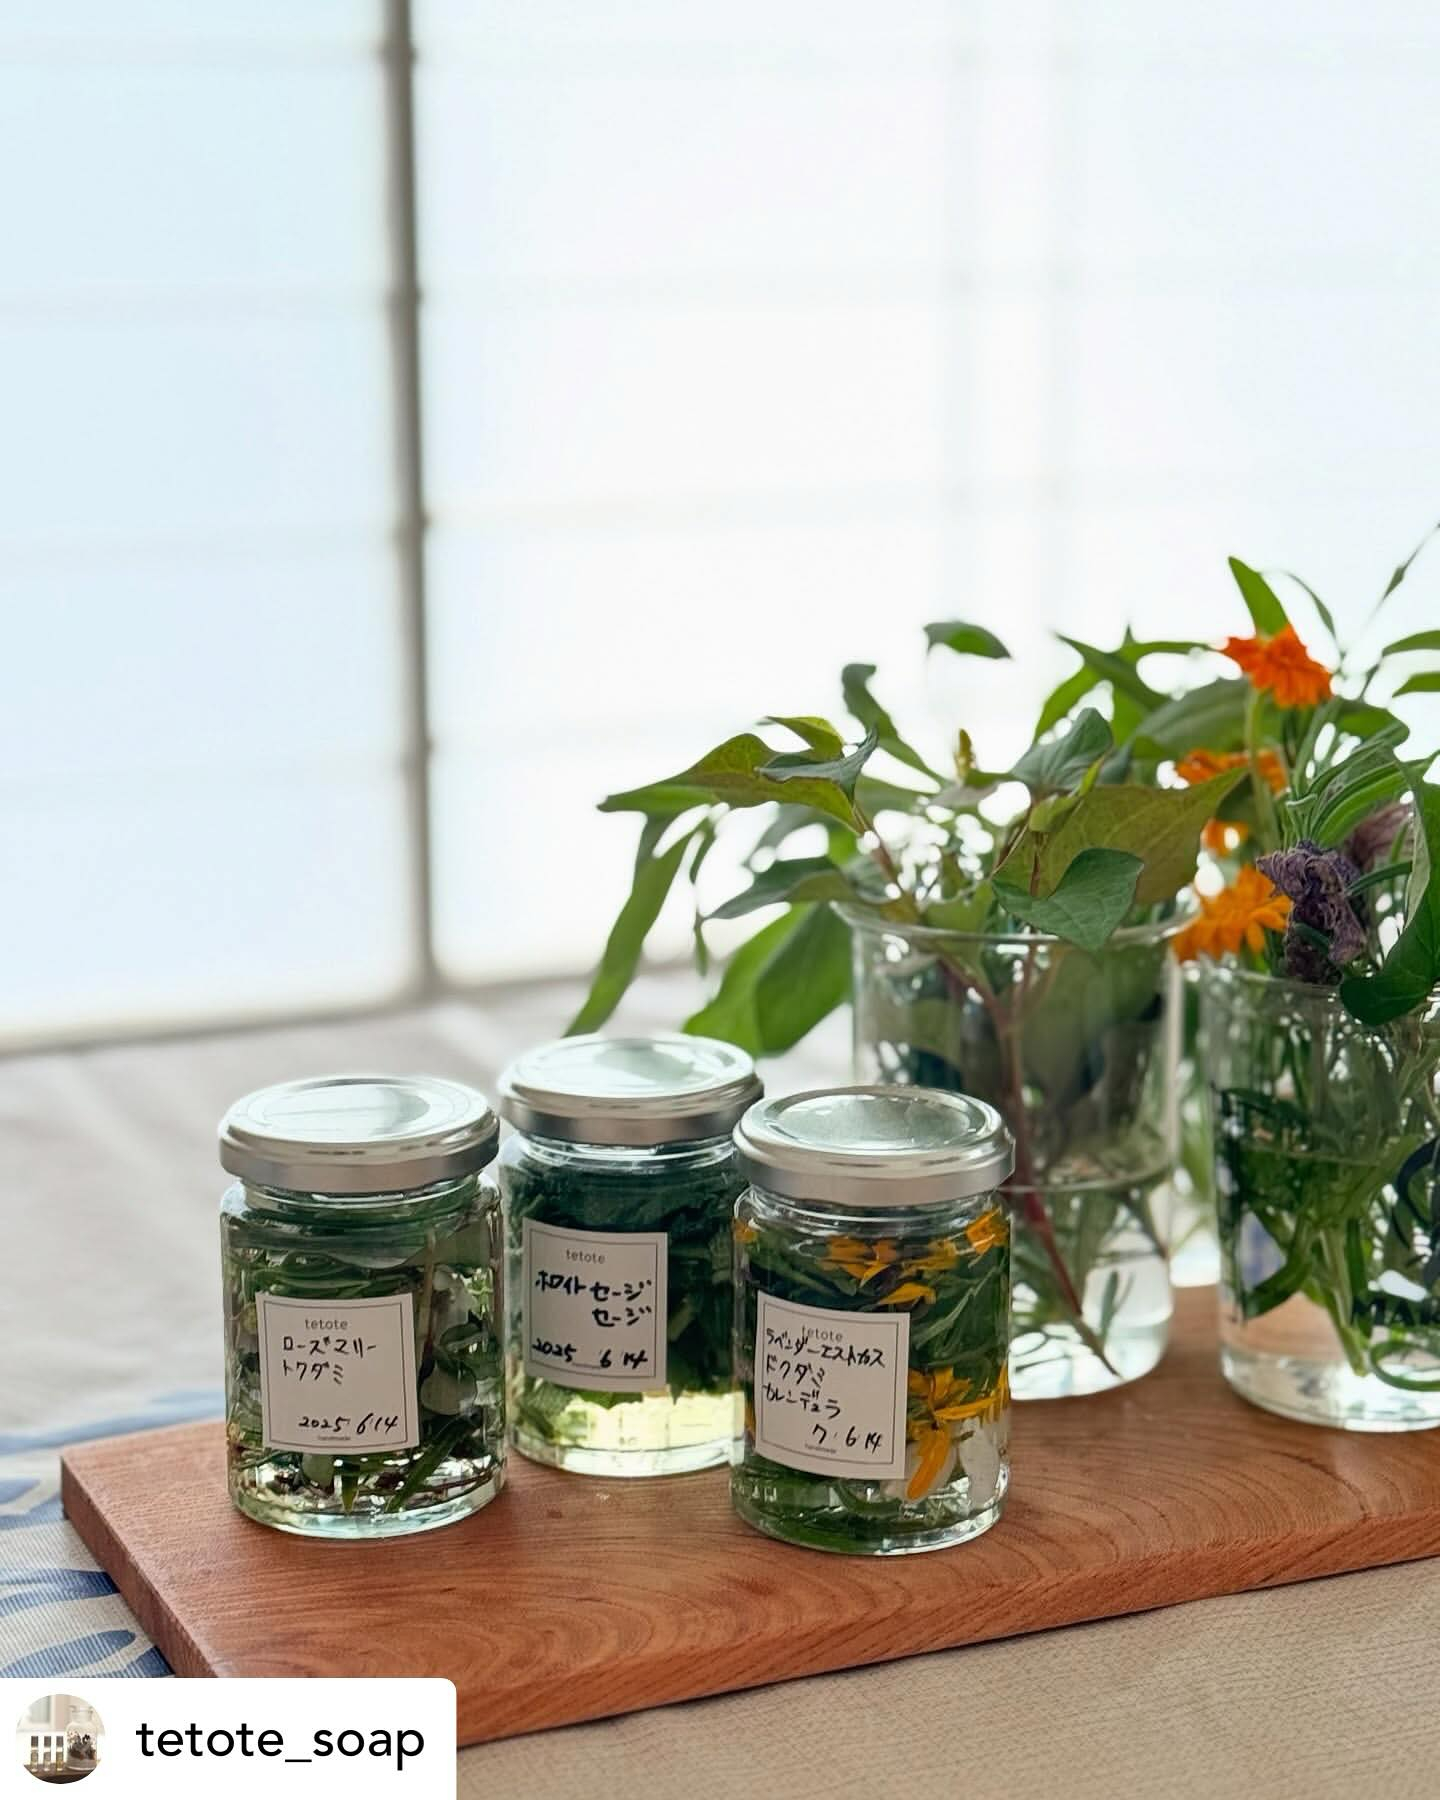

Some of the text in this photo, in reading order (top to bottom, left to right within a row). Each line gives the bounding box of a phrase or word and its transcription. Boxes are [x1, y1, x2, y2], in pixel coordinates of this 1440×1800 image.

[566, 1249, 606, 1264] tetote
[305, 1319, 348, 1330] tetote
[283, 1336, 377, 1358] ローズマリー
[298, 1416, 351, 1432] 2025
